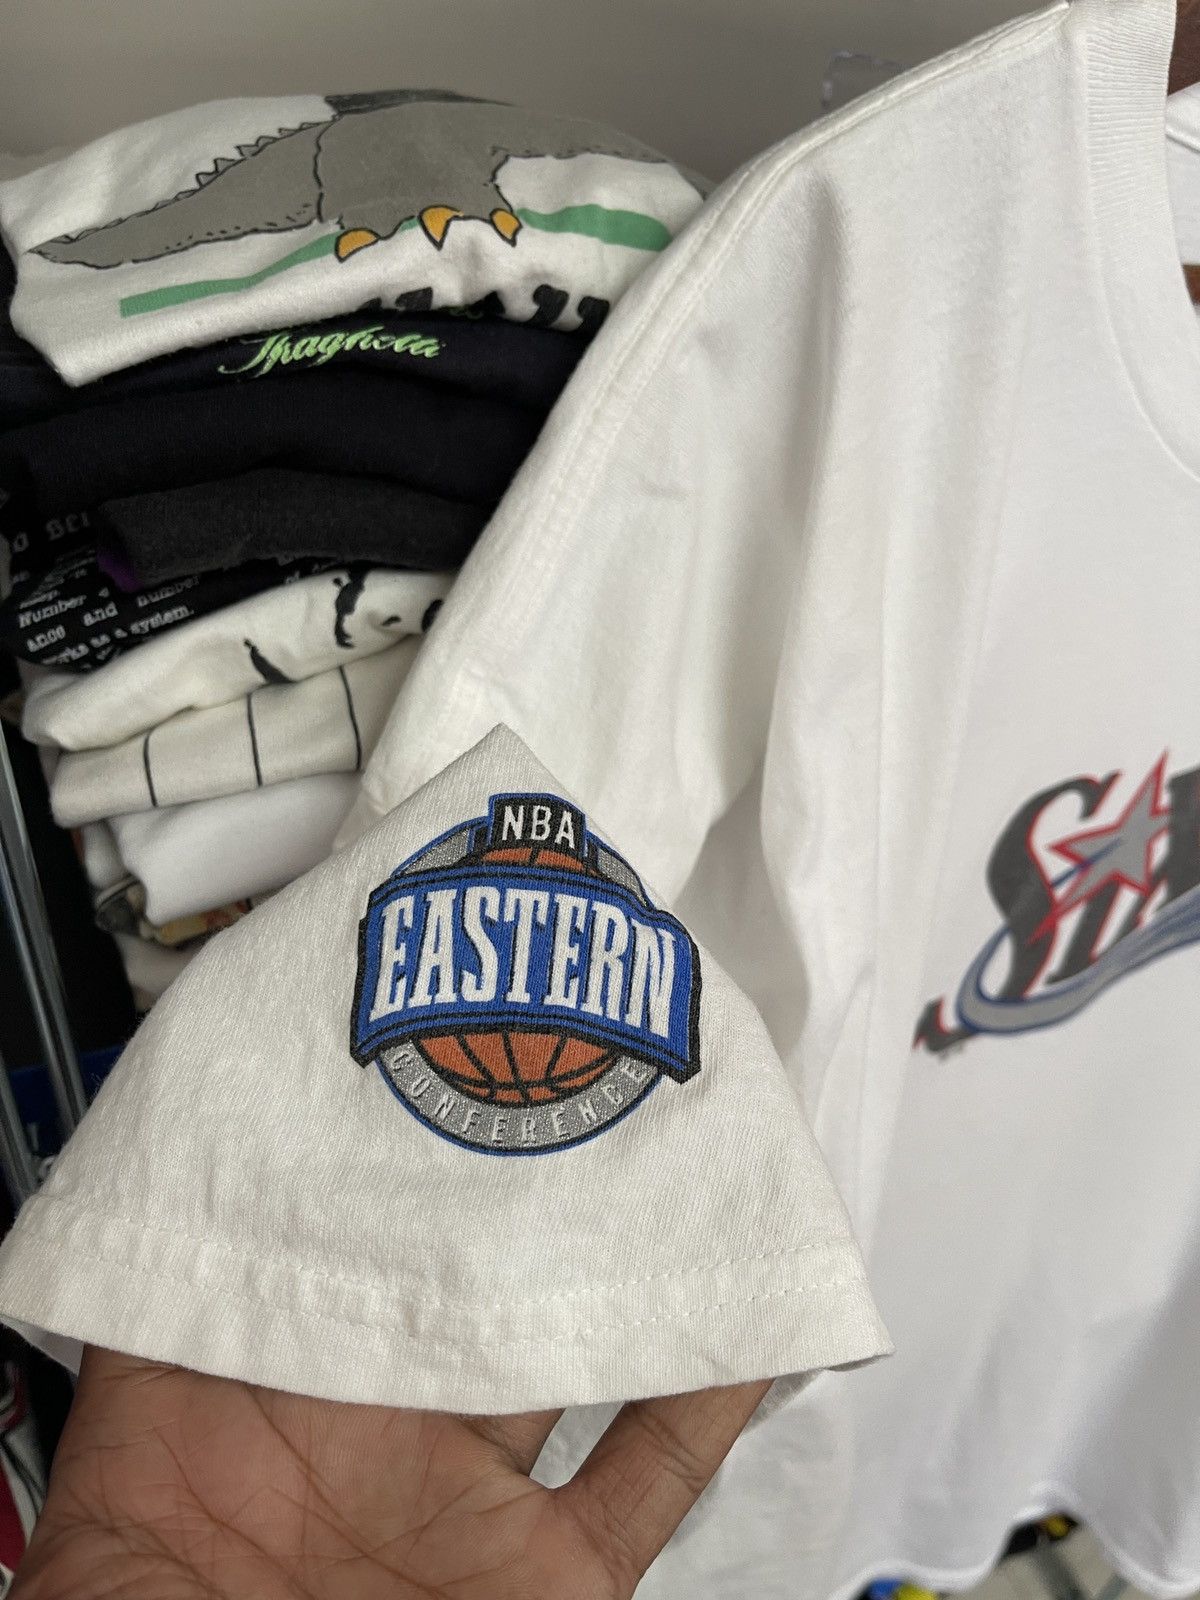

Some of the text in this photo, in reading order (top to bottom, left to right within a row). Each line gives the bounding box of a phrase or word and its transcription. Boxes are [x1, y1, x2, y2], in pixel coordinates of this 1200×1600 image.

[18, 595, 87, 628] Number
[501, 804, 576, 849] NBA
[368, 886, 678, 1040] EASTERN
[390, 1051, 649, 1143] CONFERENCE
